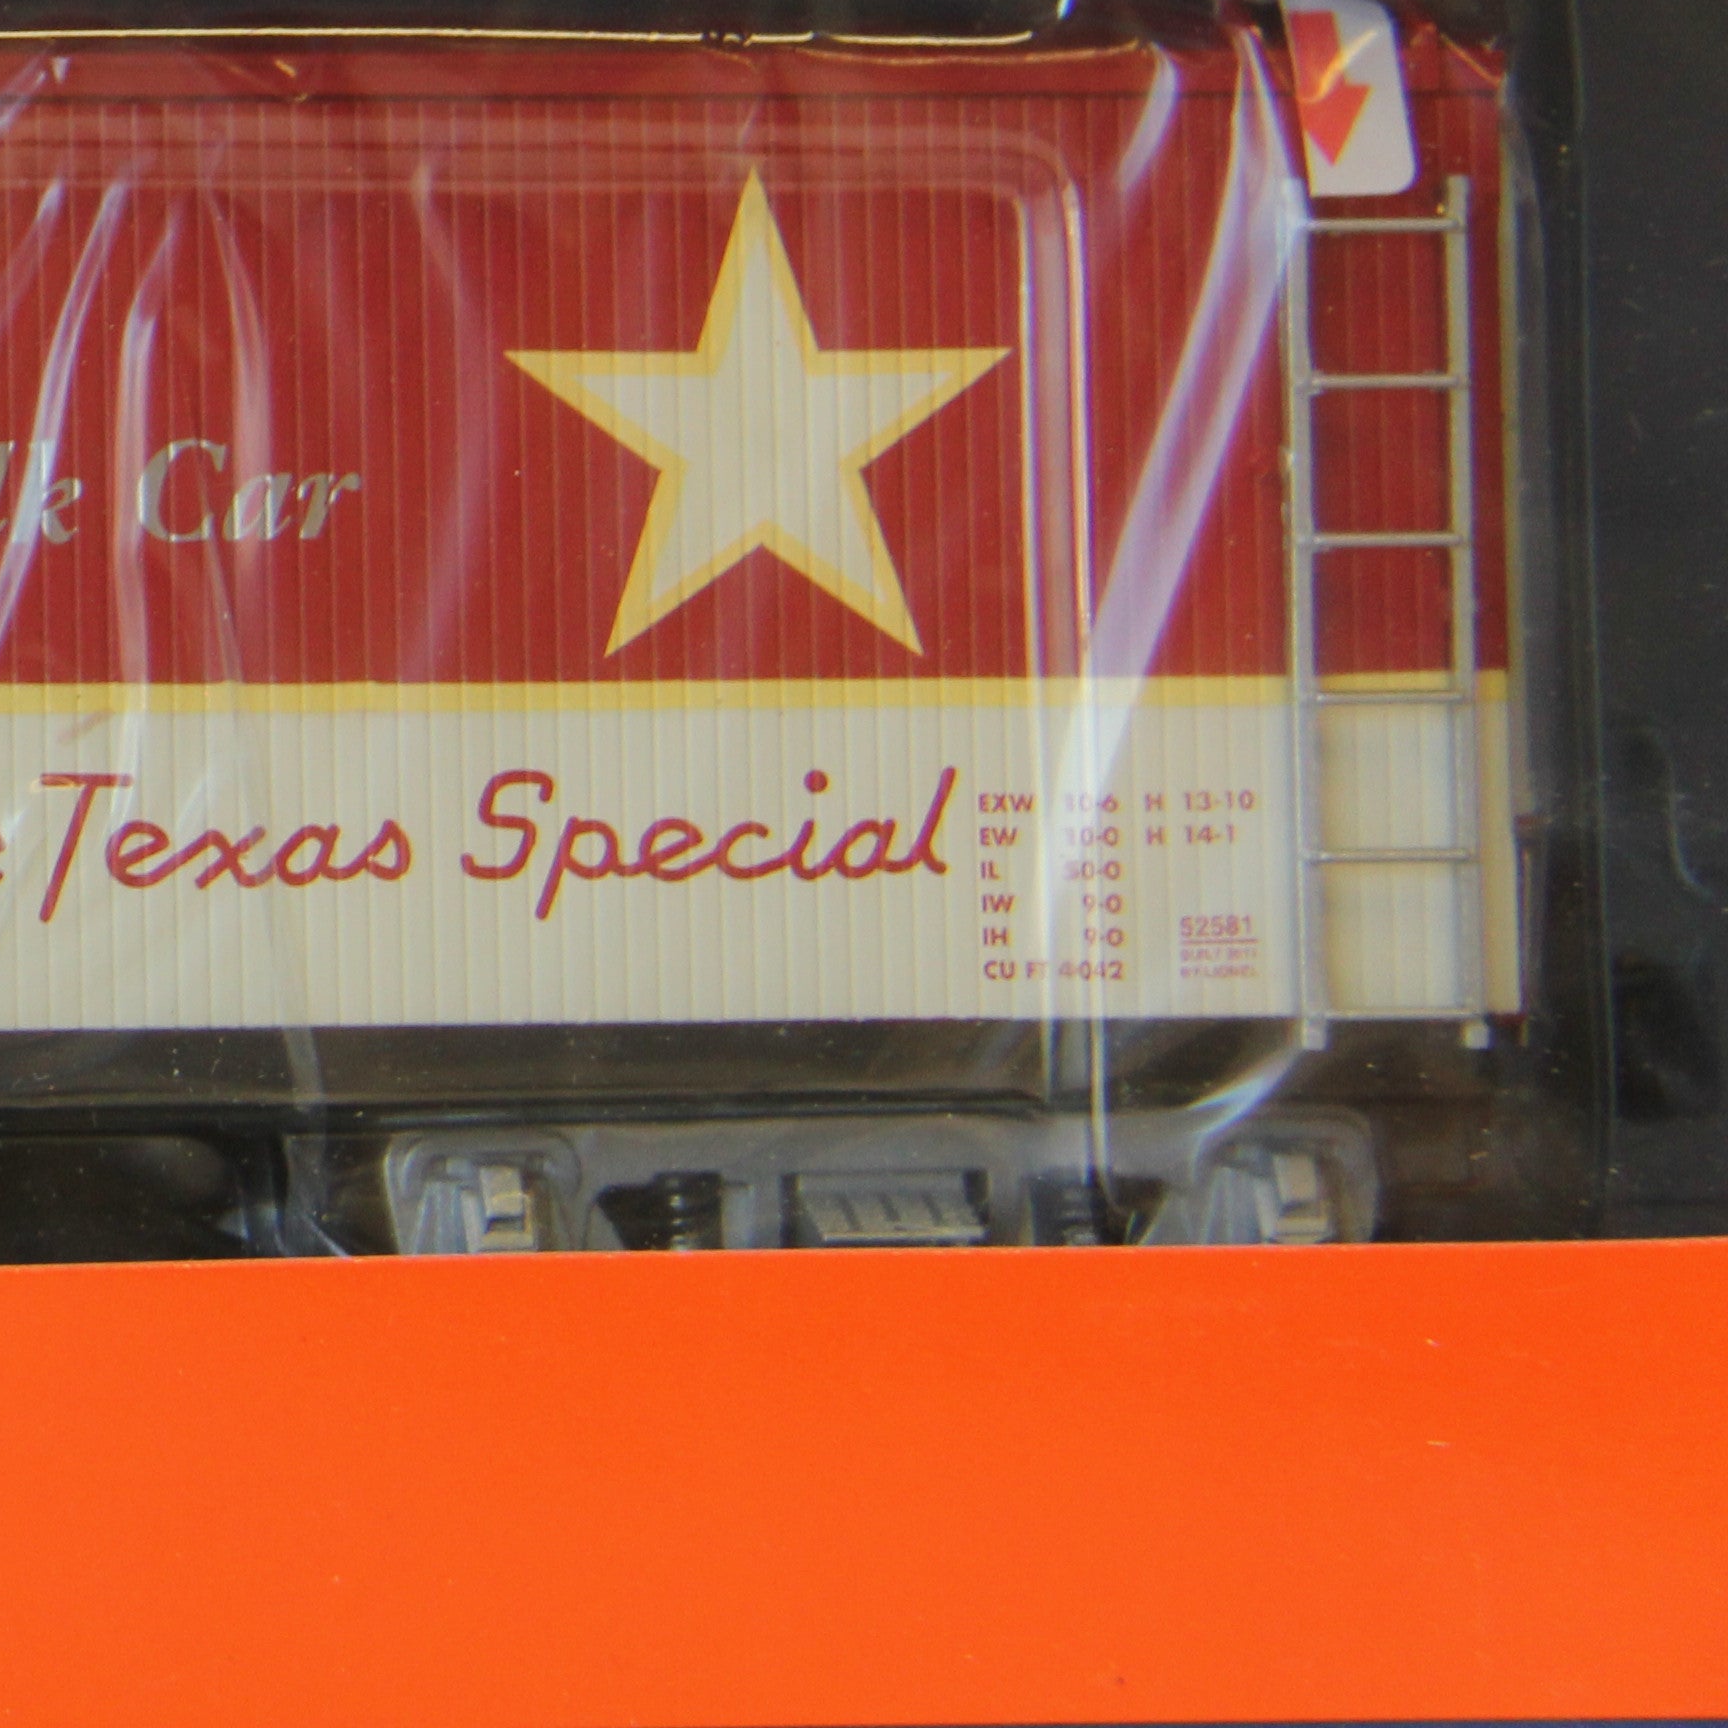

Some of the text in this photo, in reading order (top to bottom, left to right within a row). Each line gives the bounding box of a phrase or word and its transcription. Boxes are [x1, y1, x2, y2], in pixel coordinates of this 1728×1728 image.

[134, 437, 362, 544] Car
[978, 793, 1035, 813] EXW
[1145, 792, 1164, 812] H
[1184, 790, 1255, 812] 13-10
[34, 772, 414, 924] Texas
[459, 763, 958, 922] Special
[979, 827, 1019, 847] EW
[1146, 827, 1166, 846] H
[1184, 824, 1235, 845] 14-1
[981, 860, 1001, 880] IL
[982, 893, 1016, 913] IW
[983, 927, 1009, 947] IH
[984, 960, 1017, 981] CU
